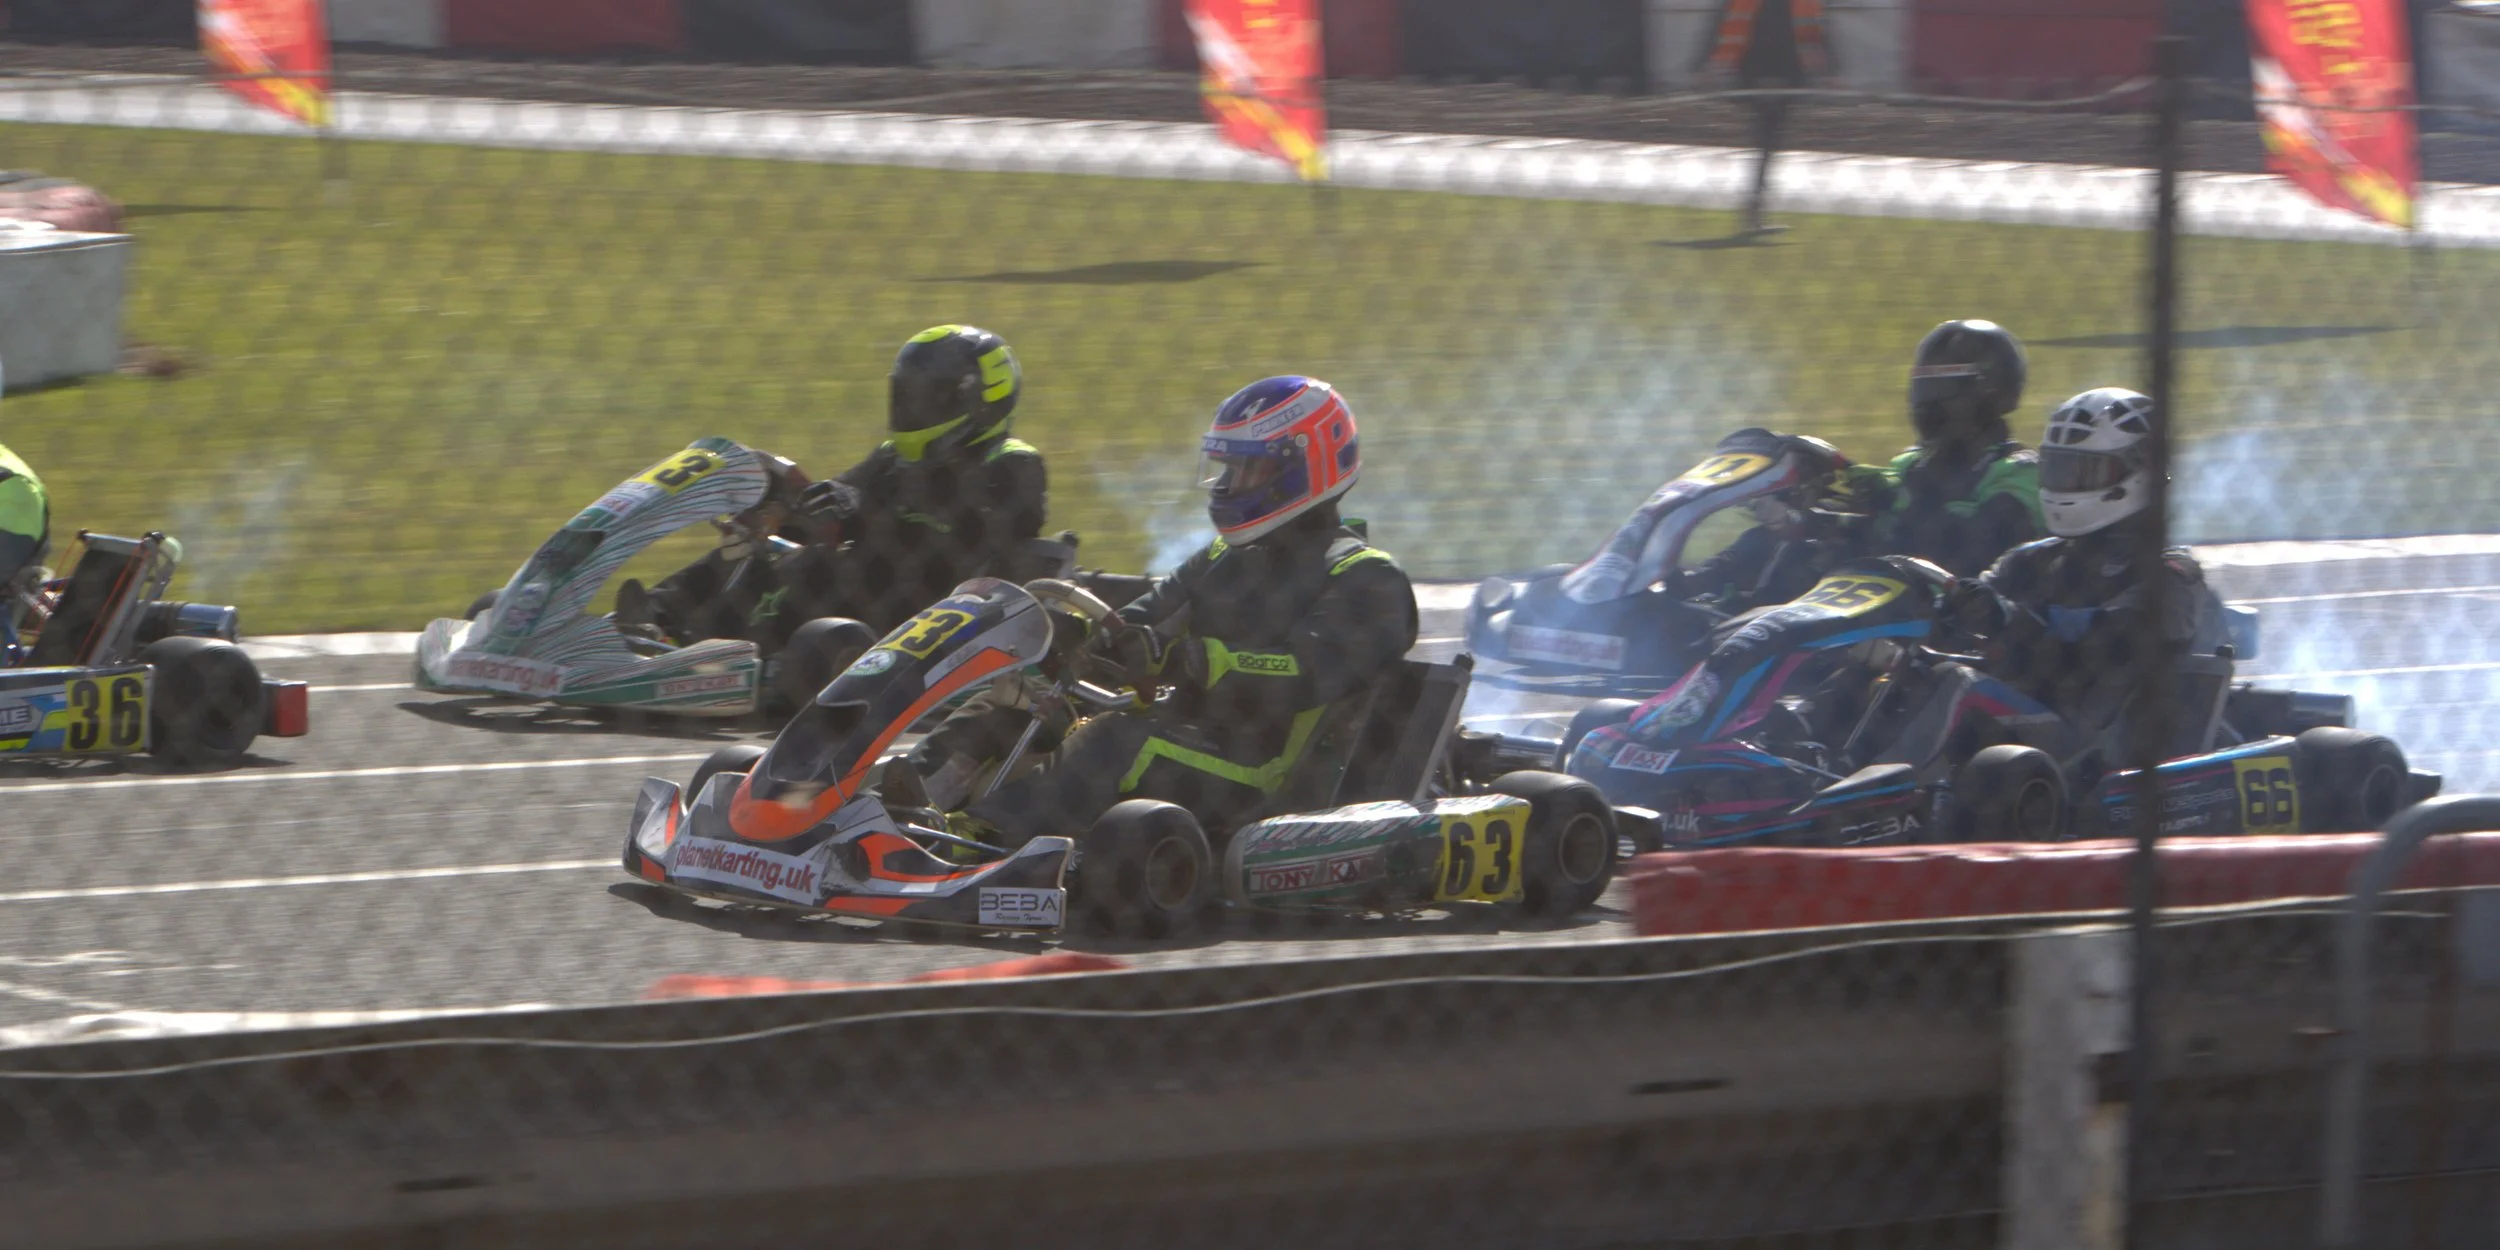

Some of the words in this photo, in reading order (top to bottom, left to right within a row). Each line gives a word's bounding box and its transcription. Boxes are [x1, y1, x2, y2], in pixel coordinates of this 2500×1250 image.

[69, 676, 142, 749] 36
[2243, 767, 2294, 827] 66
[673, 839, 816, 894] planetkarting.uk
[1252, 864, 1314, 893] TONY
[1444, 819, 1512, 896] 63
[980, 892, 1058, 912] BEBA
